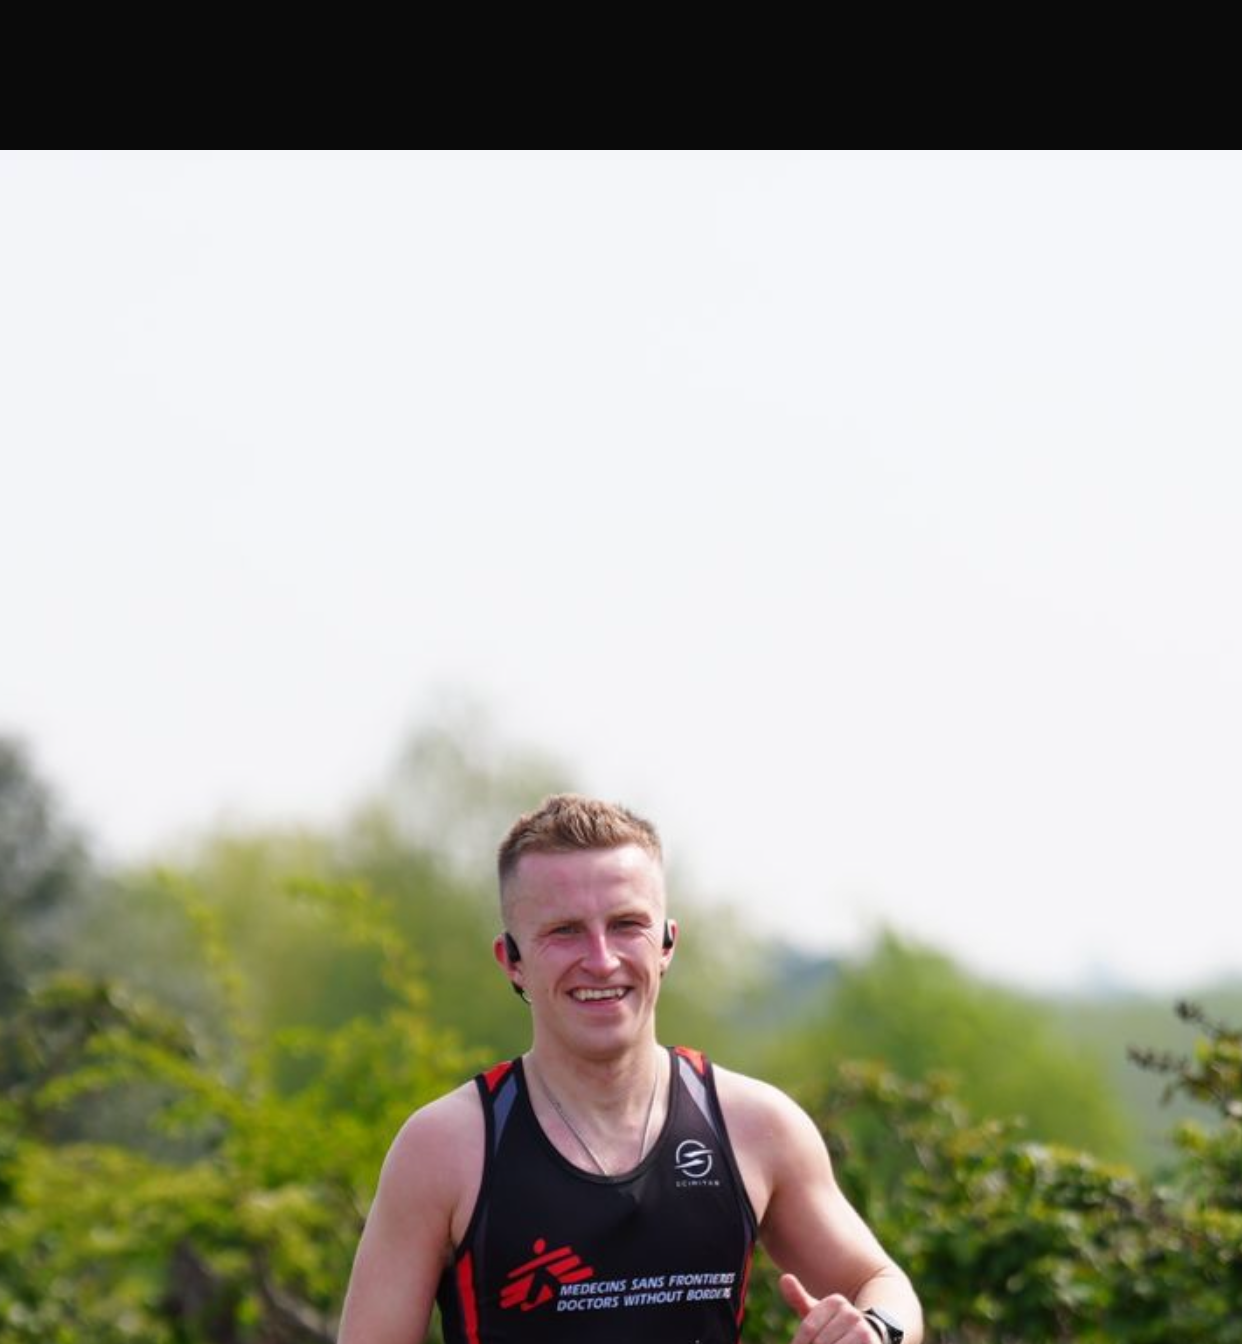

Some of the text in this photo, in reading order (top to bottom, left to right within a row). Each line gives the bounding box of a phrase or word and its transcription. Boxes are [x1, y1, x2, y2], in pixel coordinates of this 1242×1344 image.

[559, 1279, 627, 1296] MEDECINS
[631, 1276, 664, 1291] SANS
[557, 1296, 620, 1312] DOCTORS
[624, 1290, 683, 1306] WITHOUT
